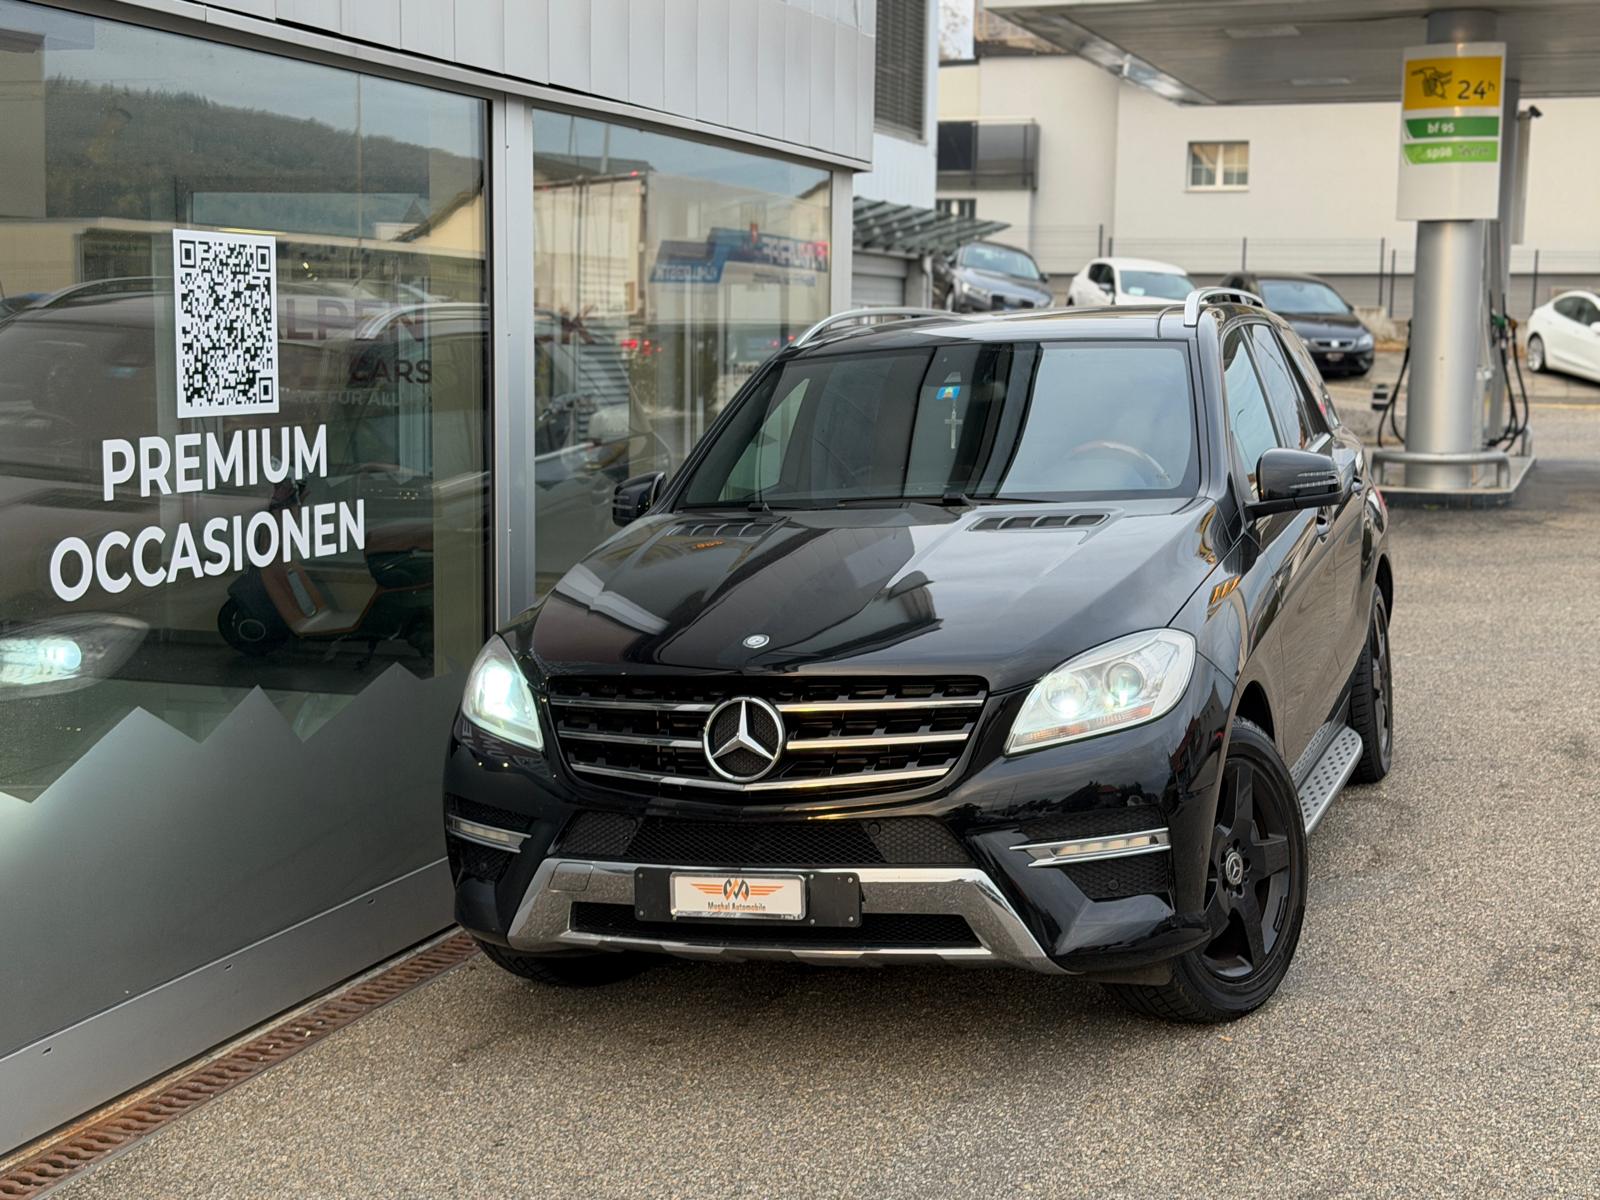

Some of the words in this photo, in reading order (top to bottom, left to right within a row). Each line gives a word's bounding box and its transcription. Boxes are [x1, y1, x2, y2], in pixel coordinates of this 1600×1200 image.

[102, 424, 328, 501] PREMIUM
[49, 499, 366, 602] OCCASIONEN
[732, 901, 767, 912] Automobile
